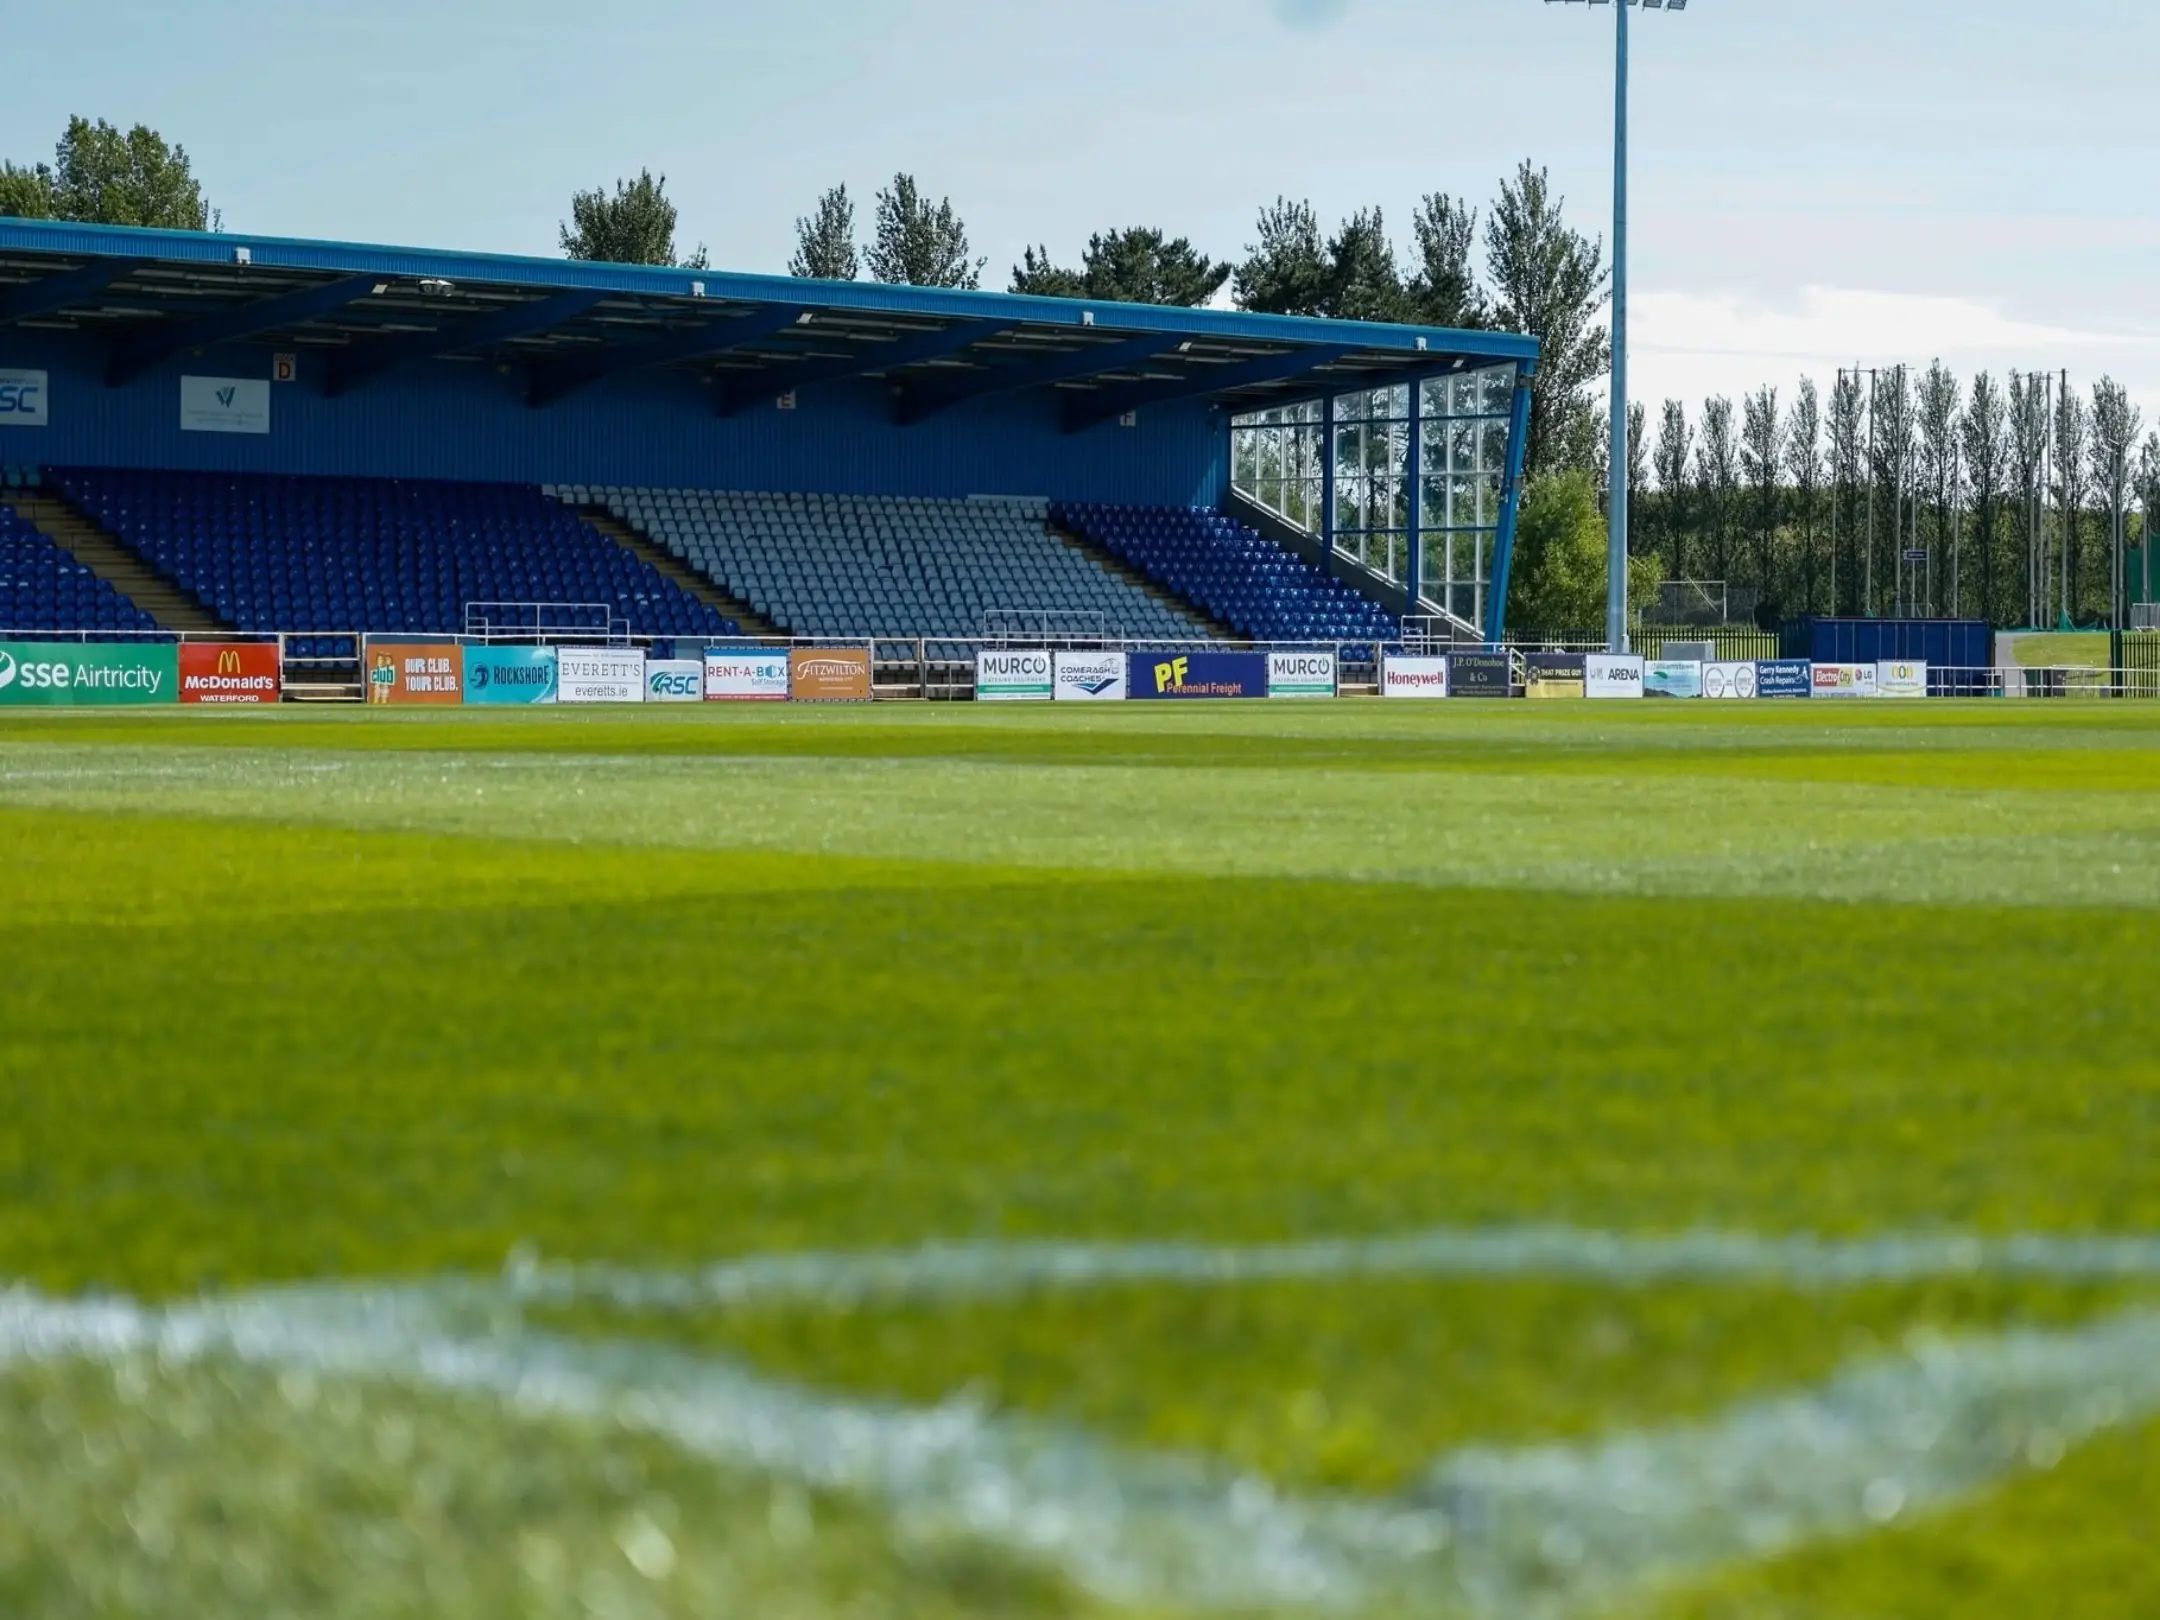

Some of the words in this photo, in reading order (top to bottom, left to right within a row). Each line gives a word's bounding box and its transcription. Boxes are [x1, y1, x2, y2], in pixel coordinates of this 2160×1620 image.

[279, 362, 290, 379] D
[404, 657, 426, 673] OUR
[428, 658, 452, 673] CLUB.
[562, 662, 641, 676] EVERETT'S
[796, 659, 865, 680] FITZWILTON
[984, 657, 1046, 674] MURCO
[1274, 657, 1329, 675] MURCO
[1760, 665, 1775, 675] Gerry
[1776, 666, 1799, 675] Kennedy
[20, 662, 70, 688] sse
[73, 664, 162, 694] Airtricity
[371, 668, 394, 683] club
[494, 665, 550, 685] ROCKSHORE
[1154, 656, 1188, 693] PF
[1387, 671, 1444, 687] Honeywell
[1470, 673, 1476, 682] &
[1477, 672, 1488, 682] Co
[1608, 668, 1640, 681] ARENA
[1760, 676, 1775, 685] Crash
[1776, 676, 1795, 686] Repairs
[1864, 670, 1872, 679] LG
[185, 676, 274, 689] McDonald's
[405, 676, 432, 691] YOUR
[434, 676, 459, 691] CLUB.
[659, 675, 699, 695] RSC
[1166, 682, 1209, 693] Perennial
[1211, 682, 1242, 696] Freight
[200, 694, 260, 702] WATERFORD
[575, 686, 628, 697] everetts.ie
